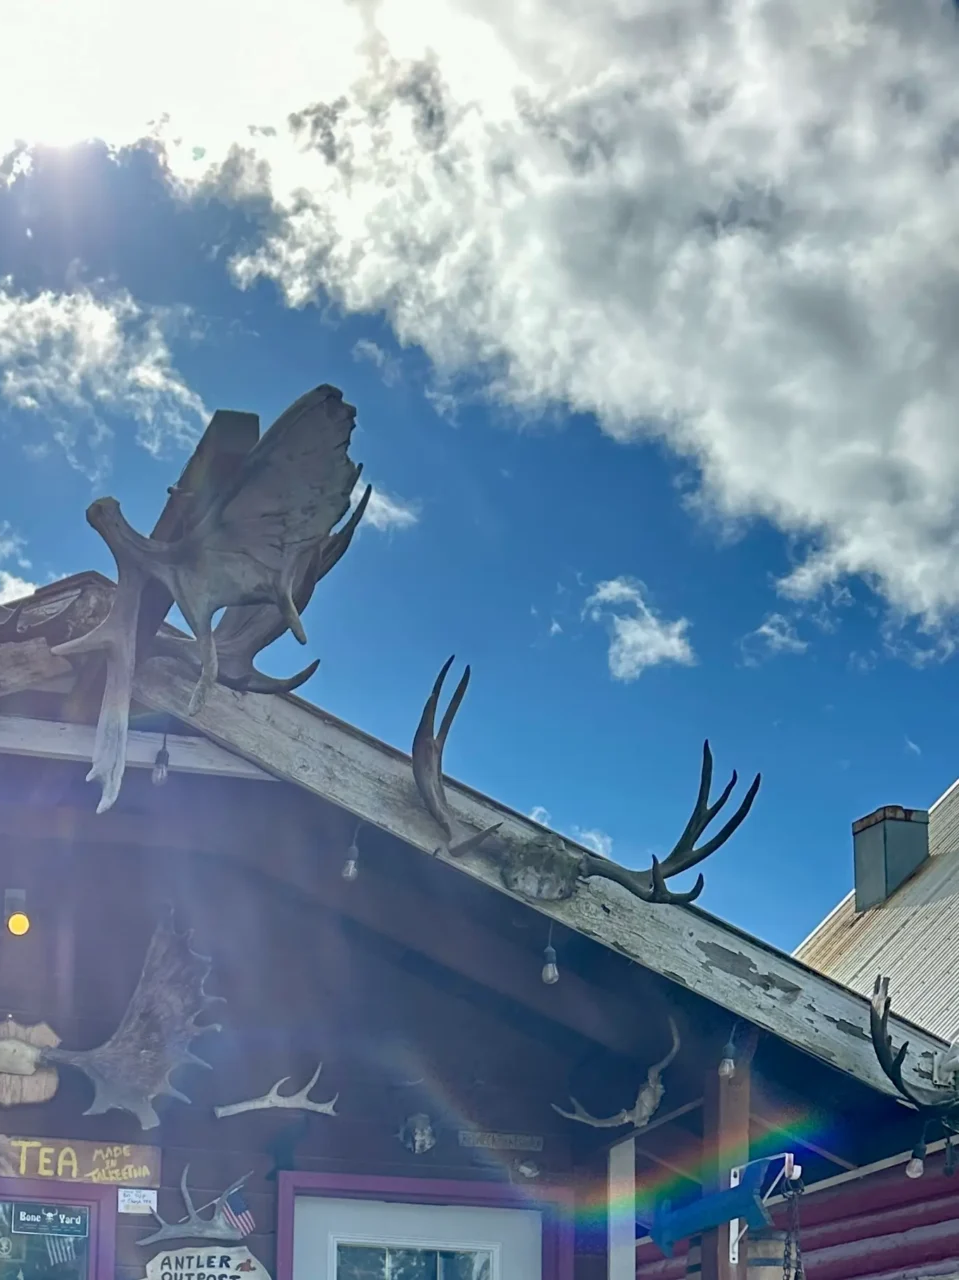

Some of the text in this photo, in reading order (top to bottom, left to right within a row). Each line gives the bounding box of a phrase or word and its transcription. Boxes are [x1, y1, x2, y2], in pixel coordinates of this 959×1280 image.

[10, 1139, 78, 1179] TEA
[92, 1144, 131, 1161] MADE
[19, 1211, 81, 1225] Bone Yard
[160, 1255, 232, 1271] ANTLER
